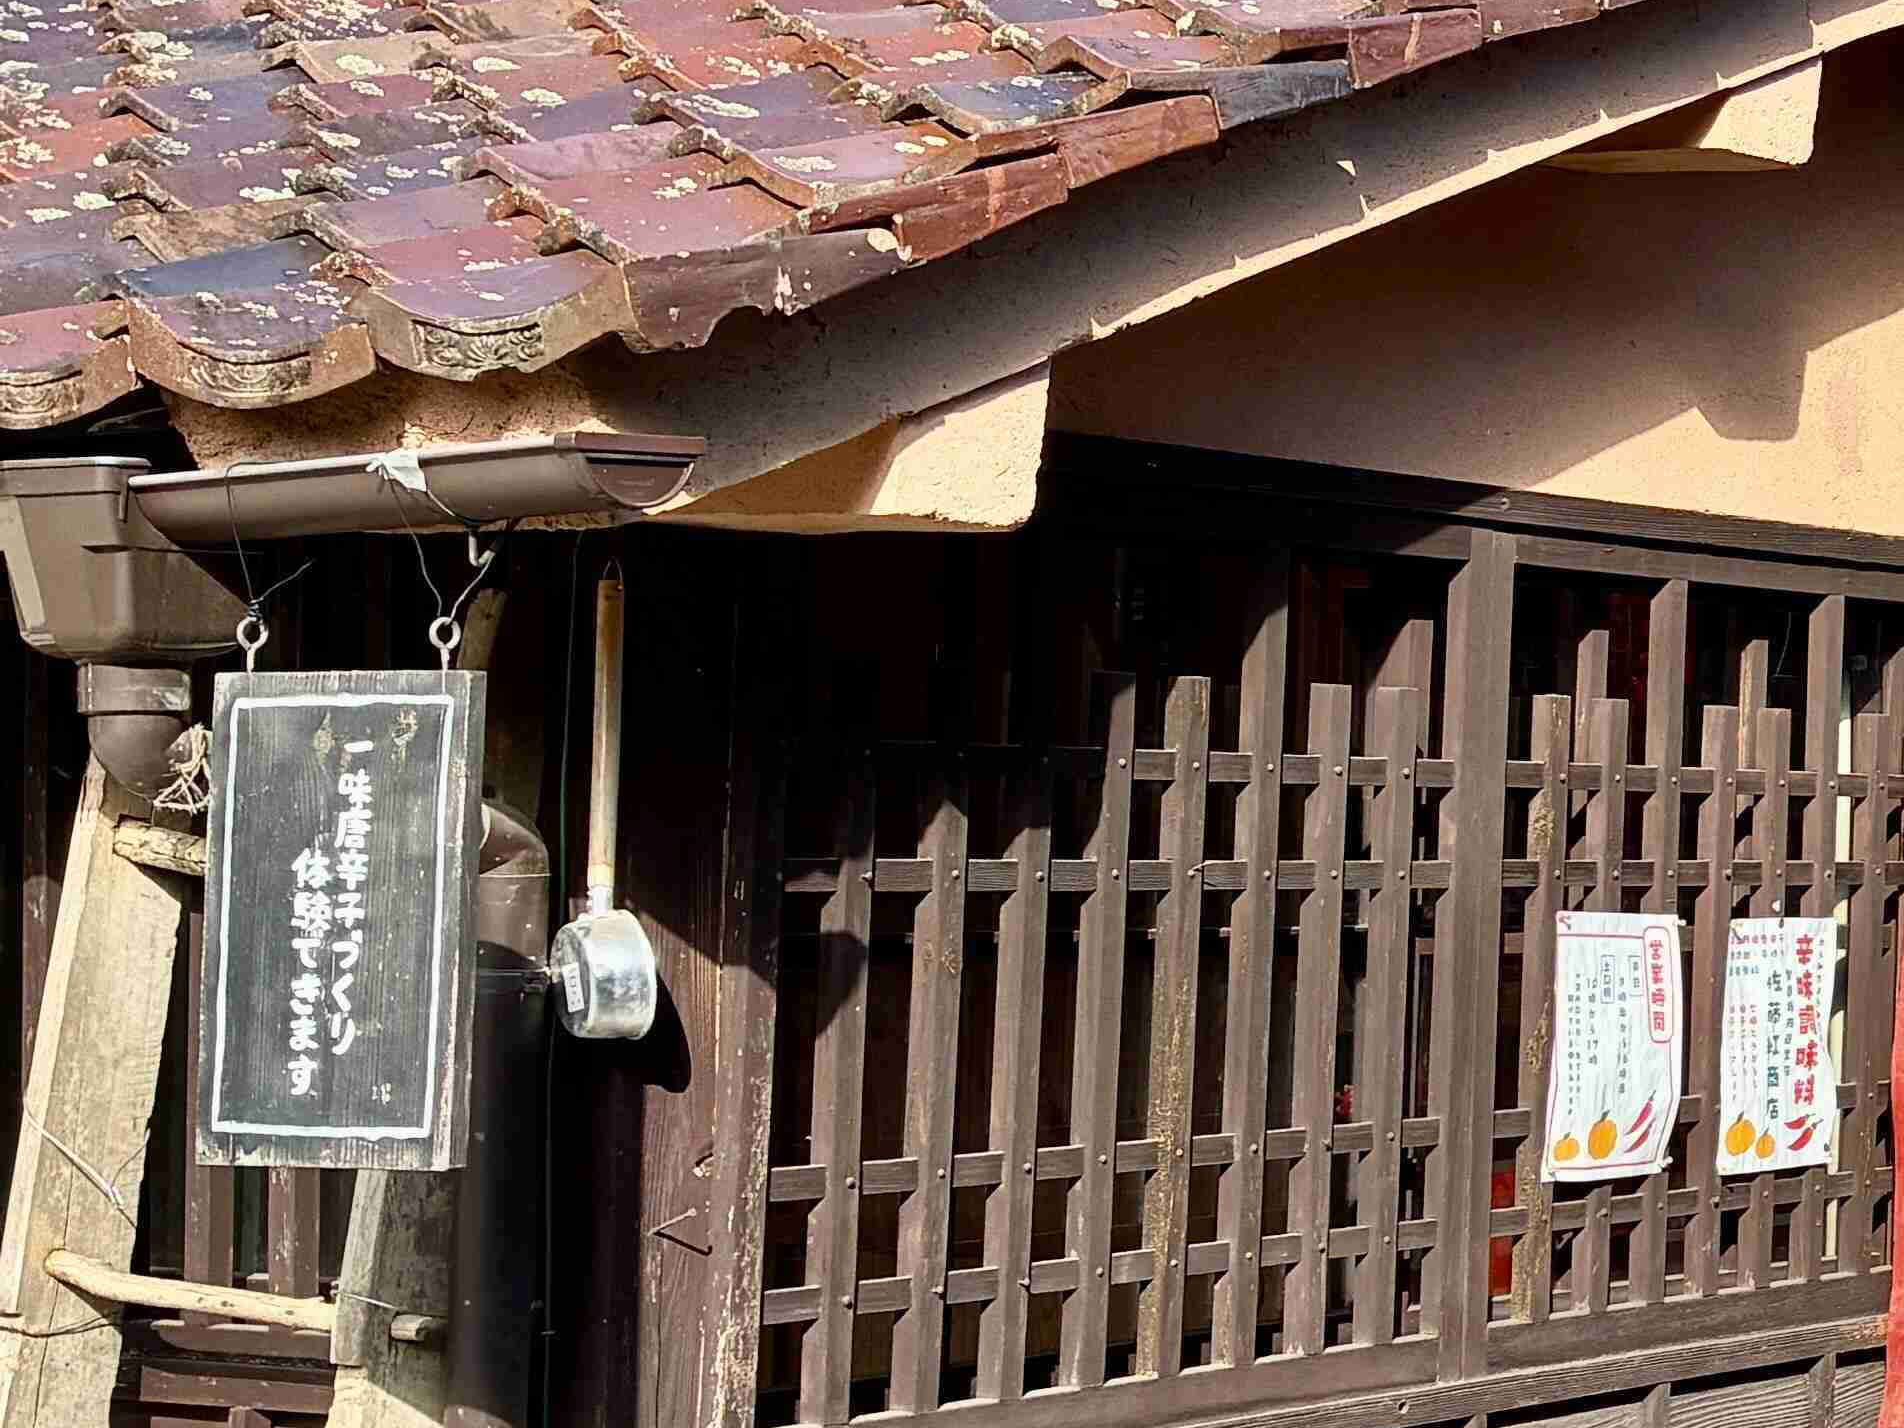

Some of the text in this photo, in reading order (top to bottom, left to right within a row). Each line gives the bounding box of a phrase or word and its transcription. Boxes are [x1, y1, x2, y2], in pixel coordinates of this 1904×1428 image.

[287, 847, 332, 1097] 体験できます
[330, 738, 374, 1056] 一味唐辛子づくり
